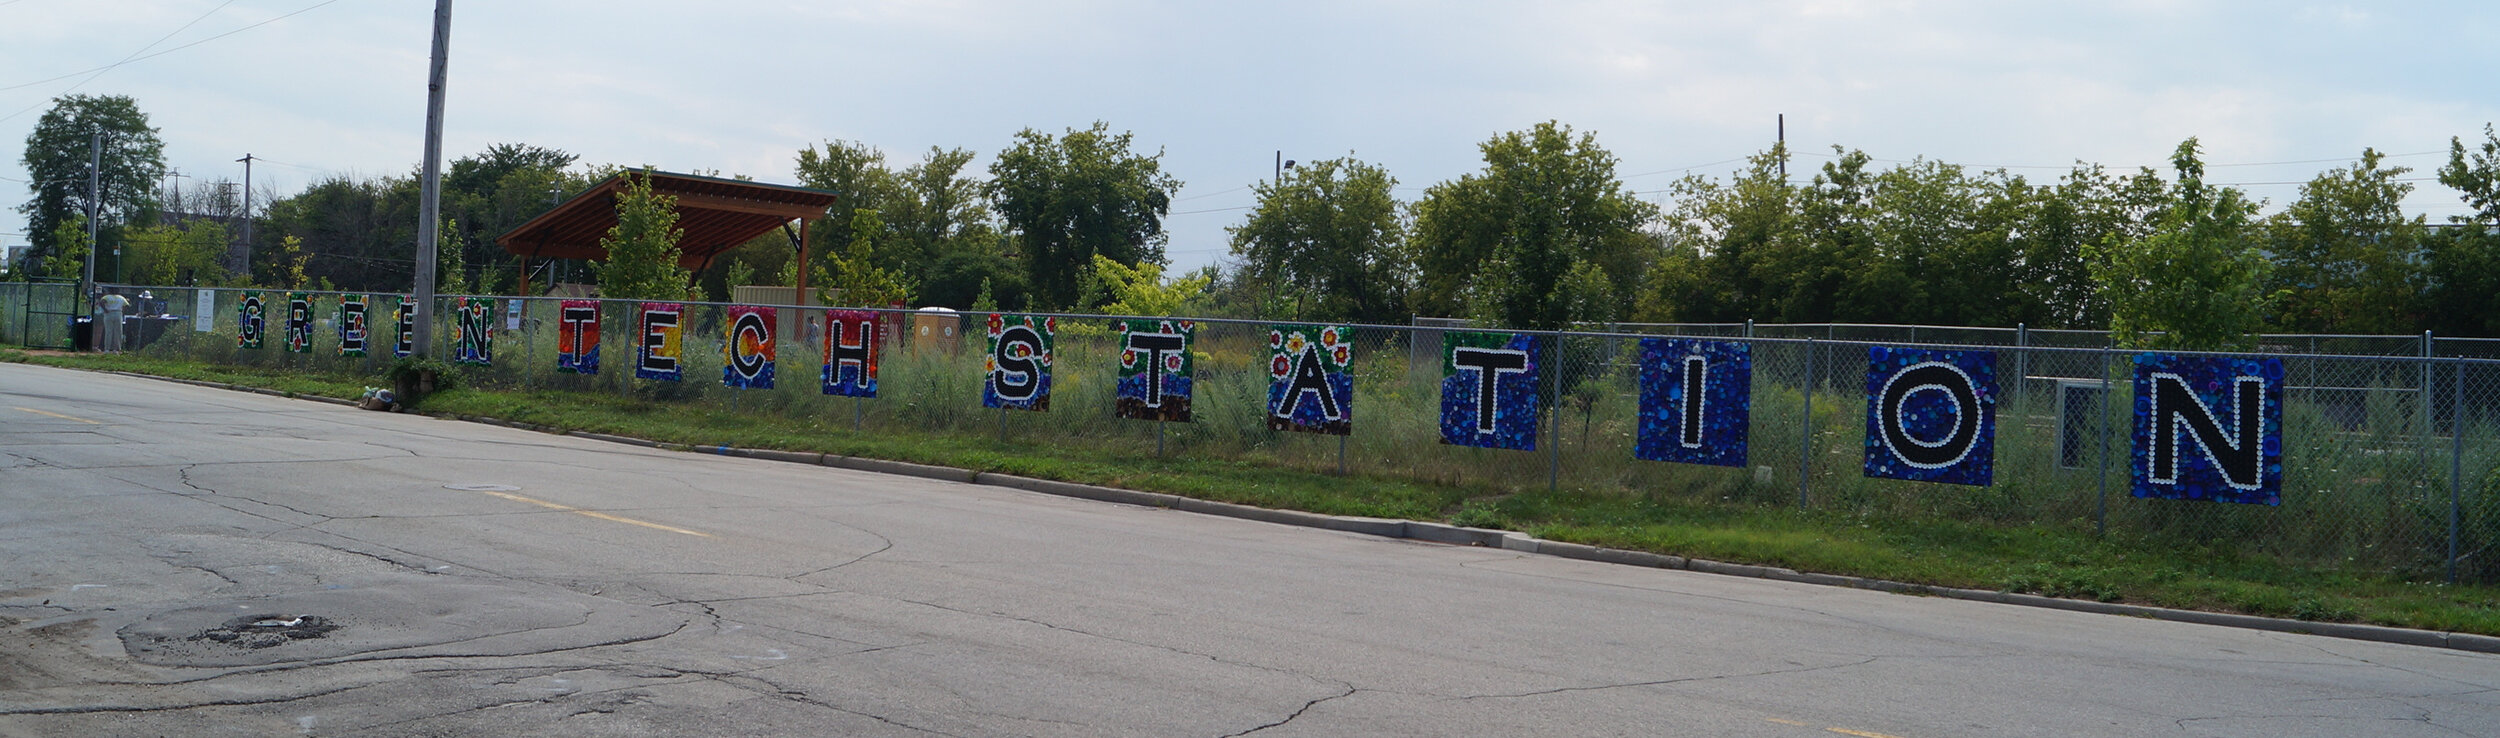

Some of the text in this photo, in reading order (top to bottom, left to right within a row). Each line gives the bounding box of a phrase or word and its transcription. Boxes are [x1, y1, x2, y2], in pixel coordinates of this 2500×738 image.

[241, 296, 490, 361] GREEN
[564, 307, 872, 389] TECH
[995, 324, 2266, 491] STATION
